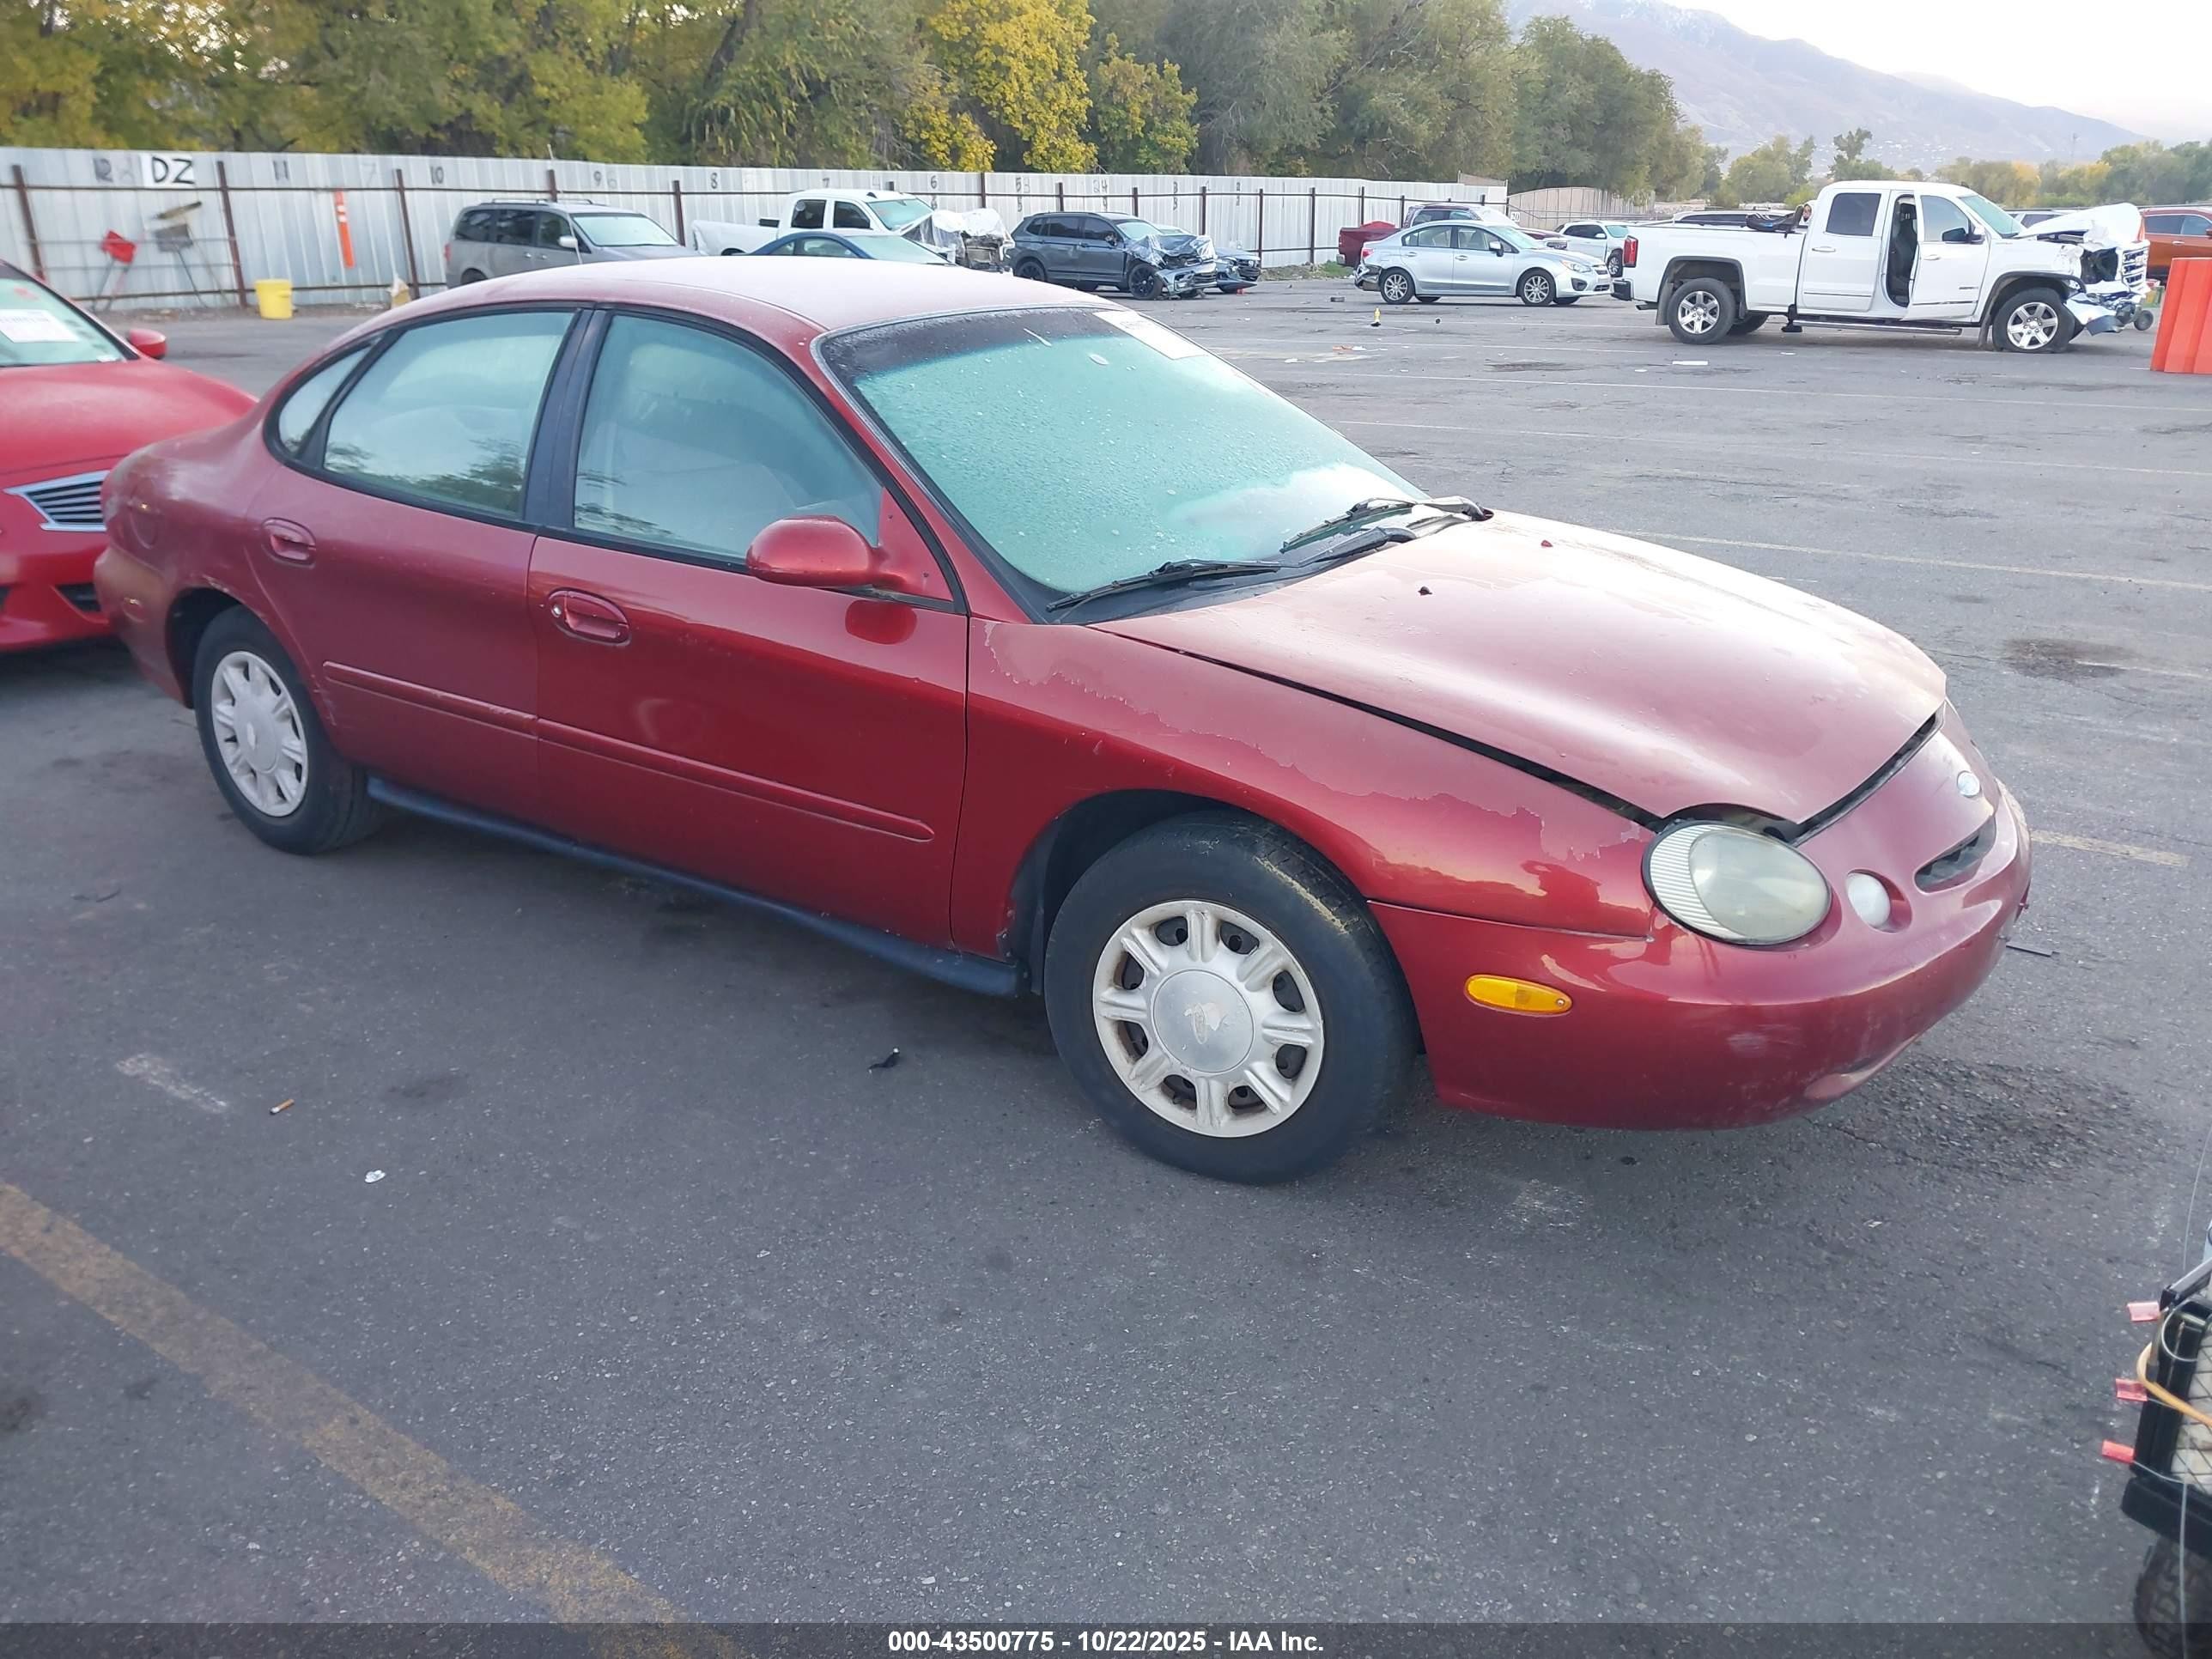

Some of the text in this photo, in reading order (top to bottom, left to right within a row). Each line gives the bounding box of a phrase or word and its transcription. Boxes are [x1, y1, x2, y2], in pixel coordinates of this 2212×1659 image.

[152, 156, 195, 184] DZ
[273, 161, 289, 180] 11
[430, 166, 444, 184] 10
[592, 171, 602, 186] 9
[710, 172, 718, 189] 8
[930, 175, 938, 189] 6
